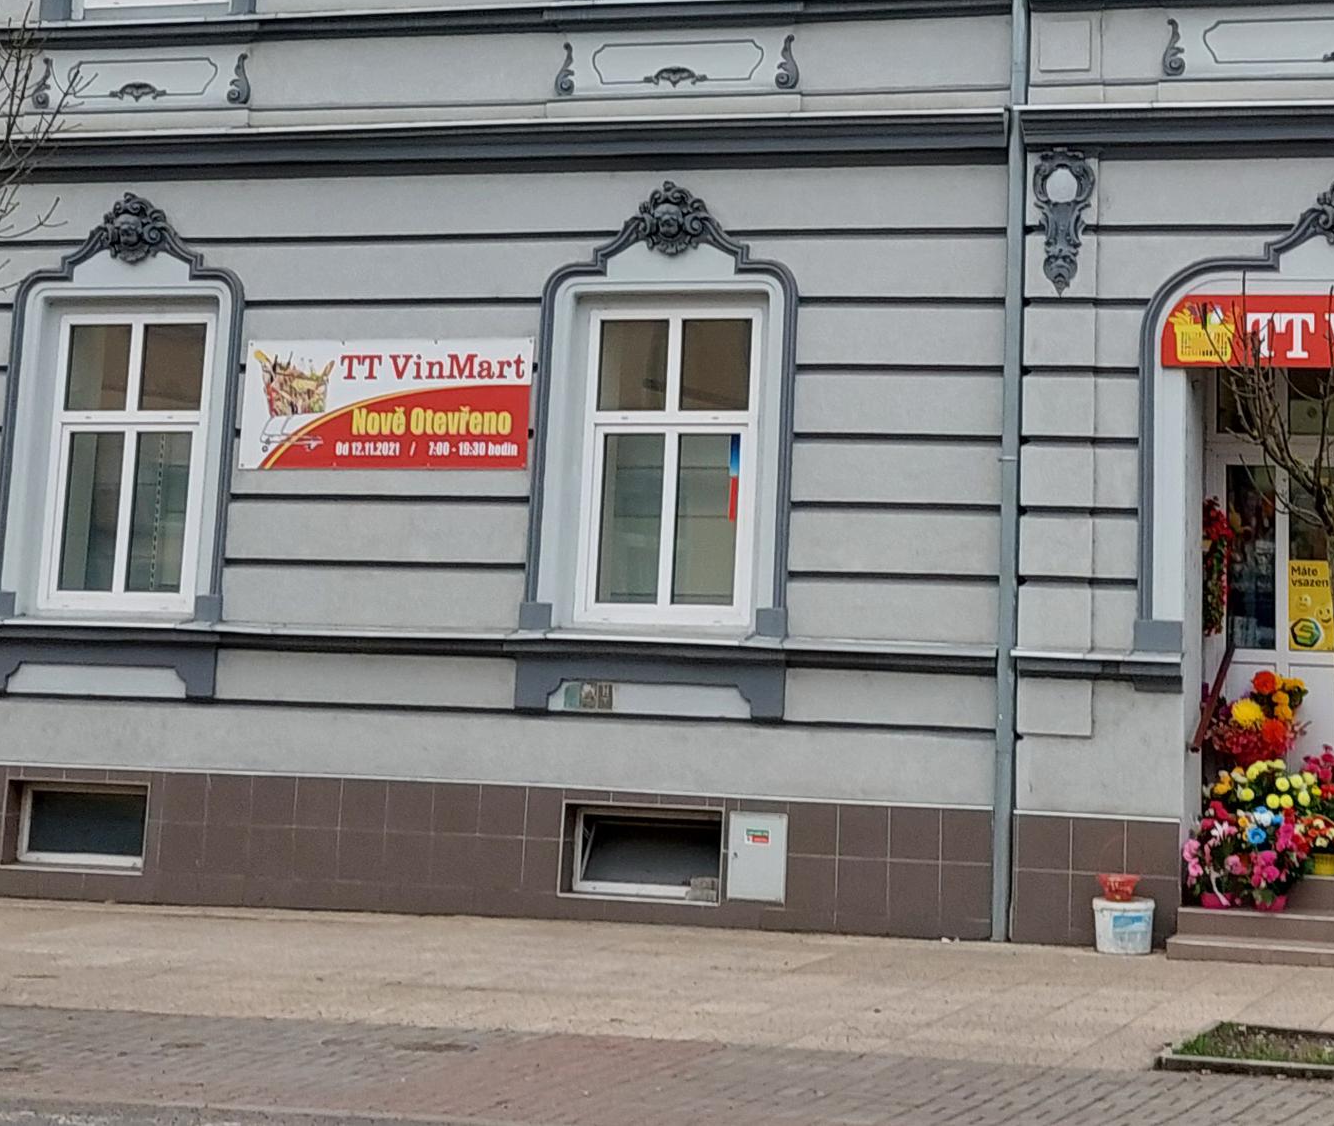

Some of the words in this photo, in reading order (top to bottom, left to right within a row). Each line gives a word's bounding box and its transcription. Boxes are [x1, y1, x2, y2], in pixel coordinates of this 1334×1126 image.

[1245, 312, 1316, 359] TT
[340, 354, 383, 380] TT
[389, 353, 526, 380] VinMart
[351, 407, 406, 436] Nově
[410, 406, 513, 436] Otevřeno
[335, 441, 349, 456] Od
[351, 441, 401, 456] 12.11.2021
[487, 441, 519, 457] hodin
[1291, 565, 1319, 577] Máte
[1291, 578, 1330, 588] vsazen
